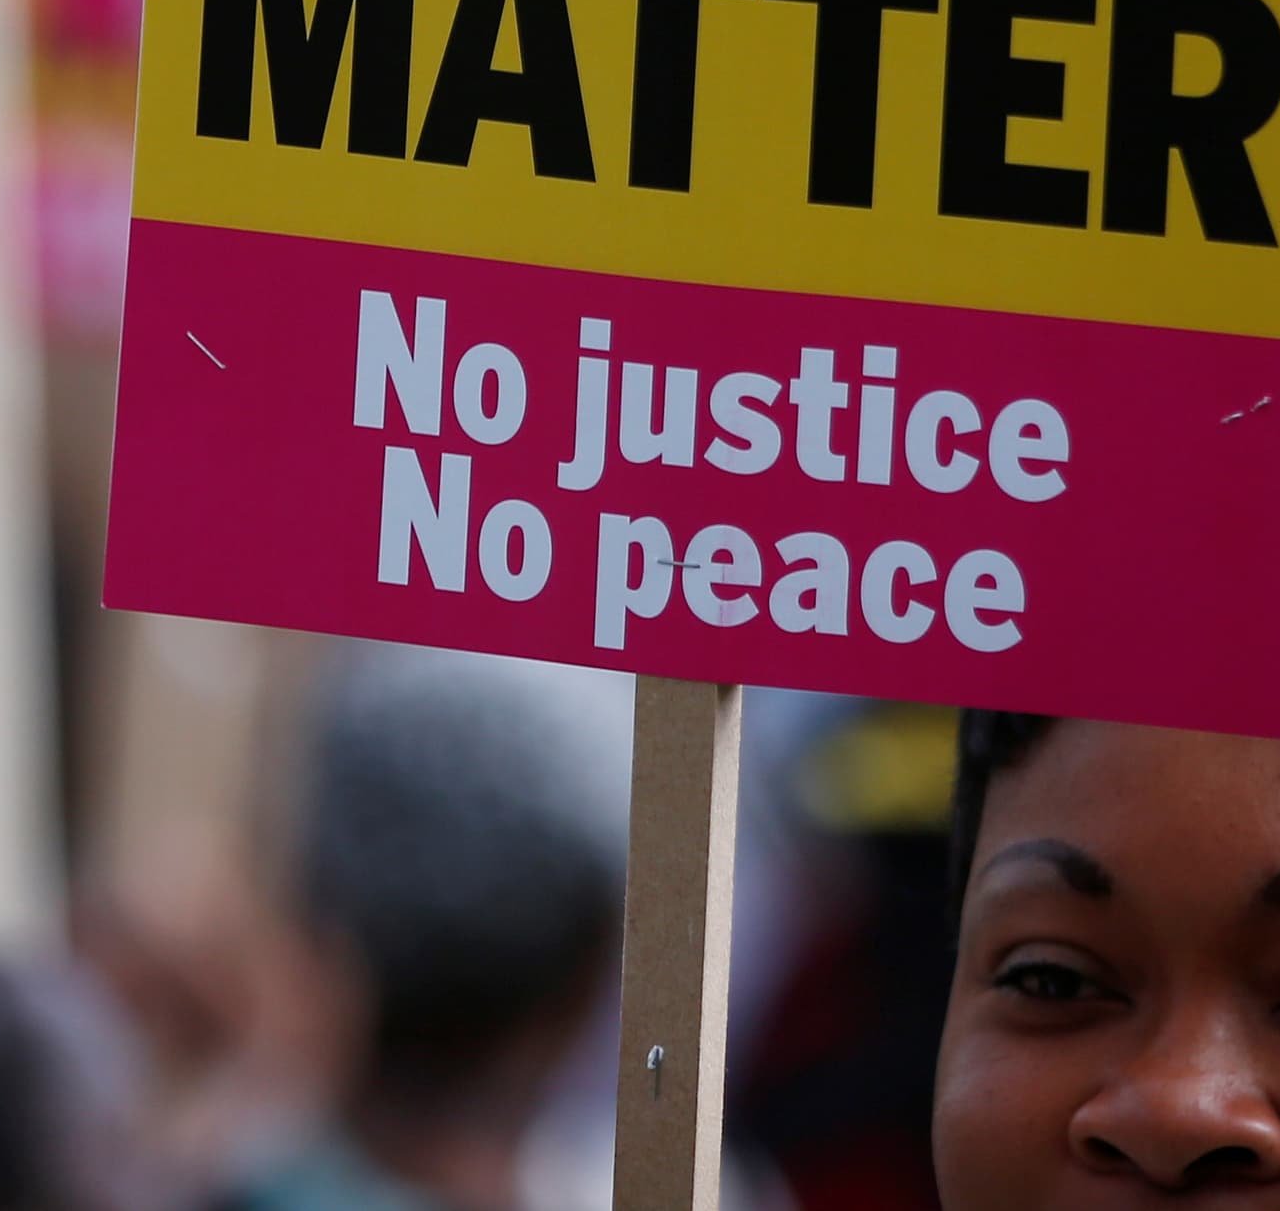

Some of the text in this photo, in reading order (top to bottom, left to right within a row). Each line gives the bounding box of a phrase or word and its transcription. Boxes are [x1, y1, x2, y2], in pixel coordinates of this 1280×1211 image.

[351, 288, 1071, 504] No justice
[376, 444, 1027, 654] No peace
